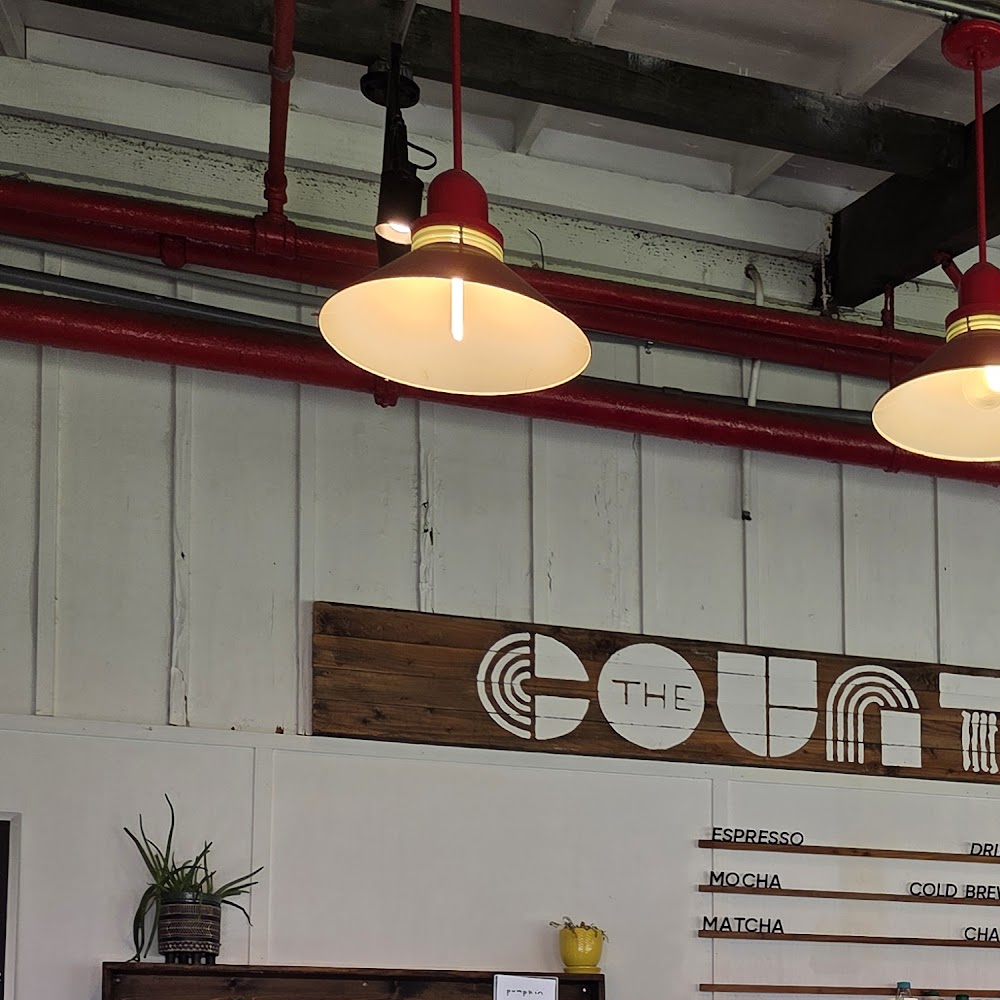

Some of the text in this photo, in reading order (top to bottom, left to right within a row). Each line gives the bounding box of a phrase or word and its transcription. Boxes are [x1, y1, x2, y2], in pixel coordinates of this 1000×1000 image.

[612, 678, 692, 713] THE
[711, 827, 804, 846] ESPRESSO
[709, 870, 782, 889] MOCHA
[909, 882, 958, 898] COLD
[702, 916, 784, 934] MATCHA
